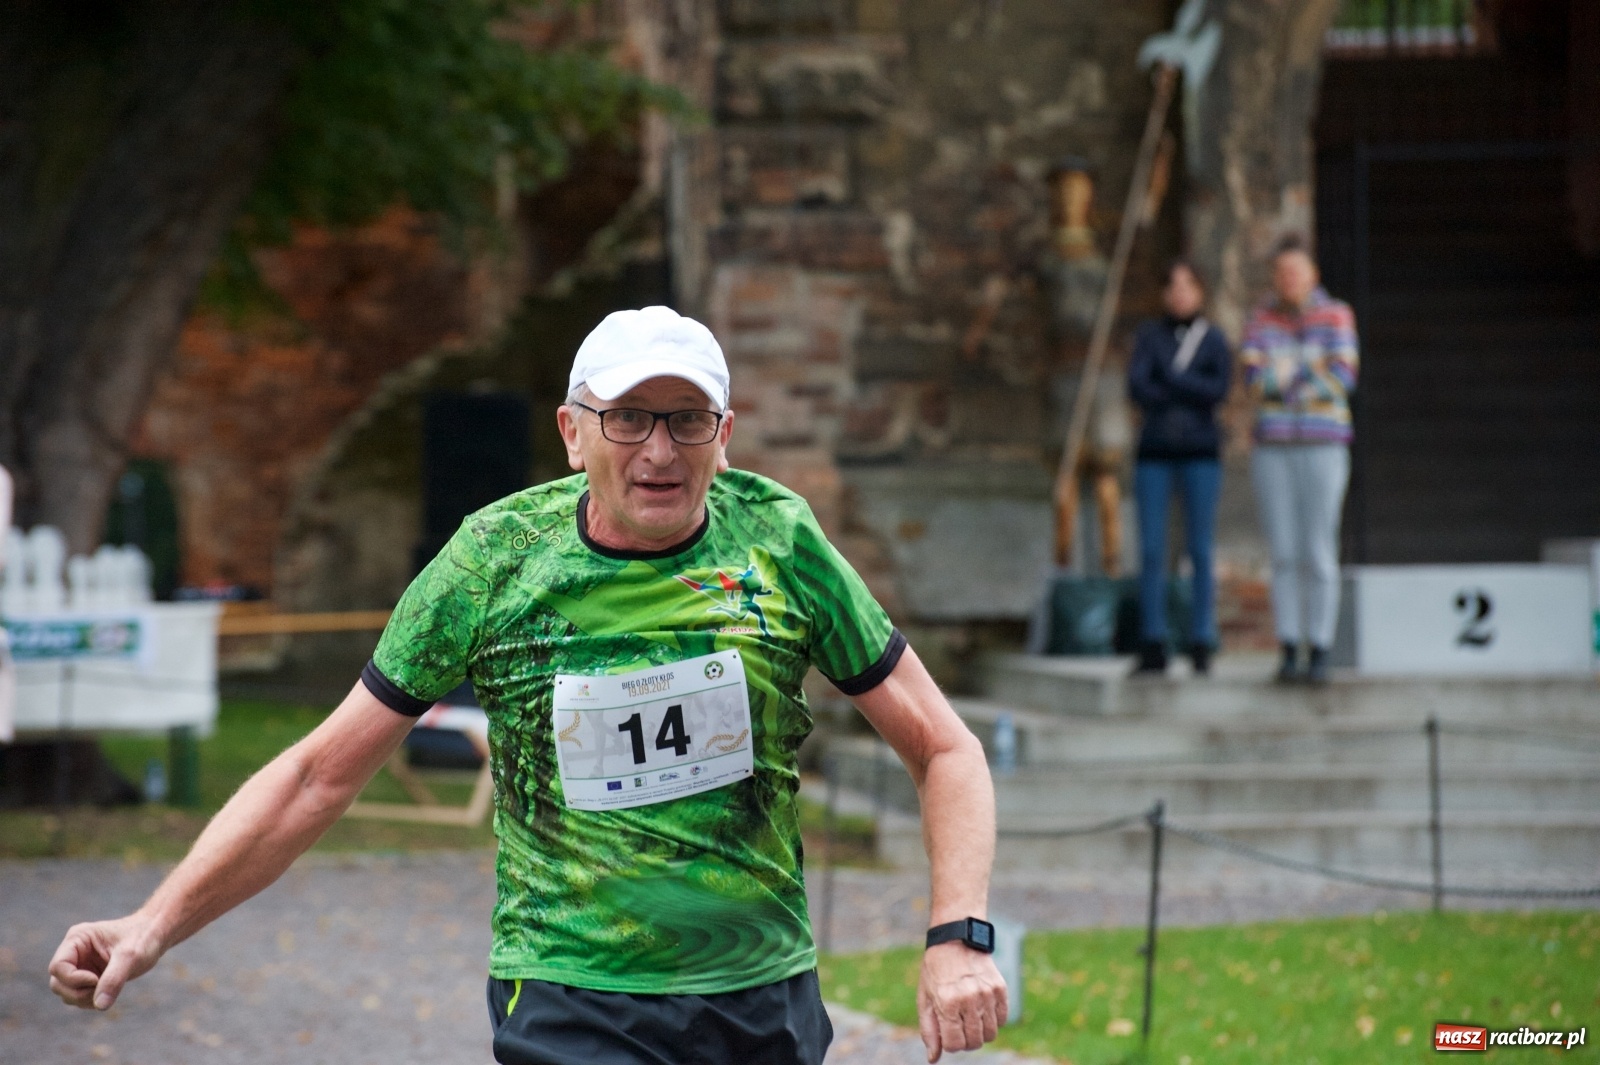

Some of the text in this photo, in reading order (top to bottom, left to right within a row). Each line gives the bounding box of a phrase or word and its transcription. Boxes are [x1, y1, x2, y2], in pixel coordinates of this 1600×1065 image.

[1454, 588, 1494, 648] 2
[628, 681, 670, 697] 19.09.2021
[618, 704, 691, 765] 14
